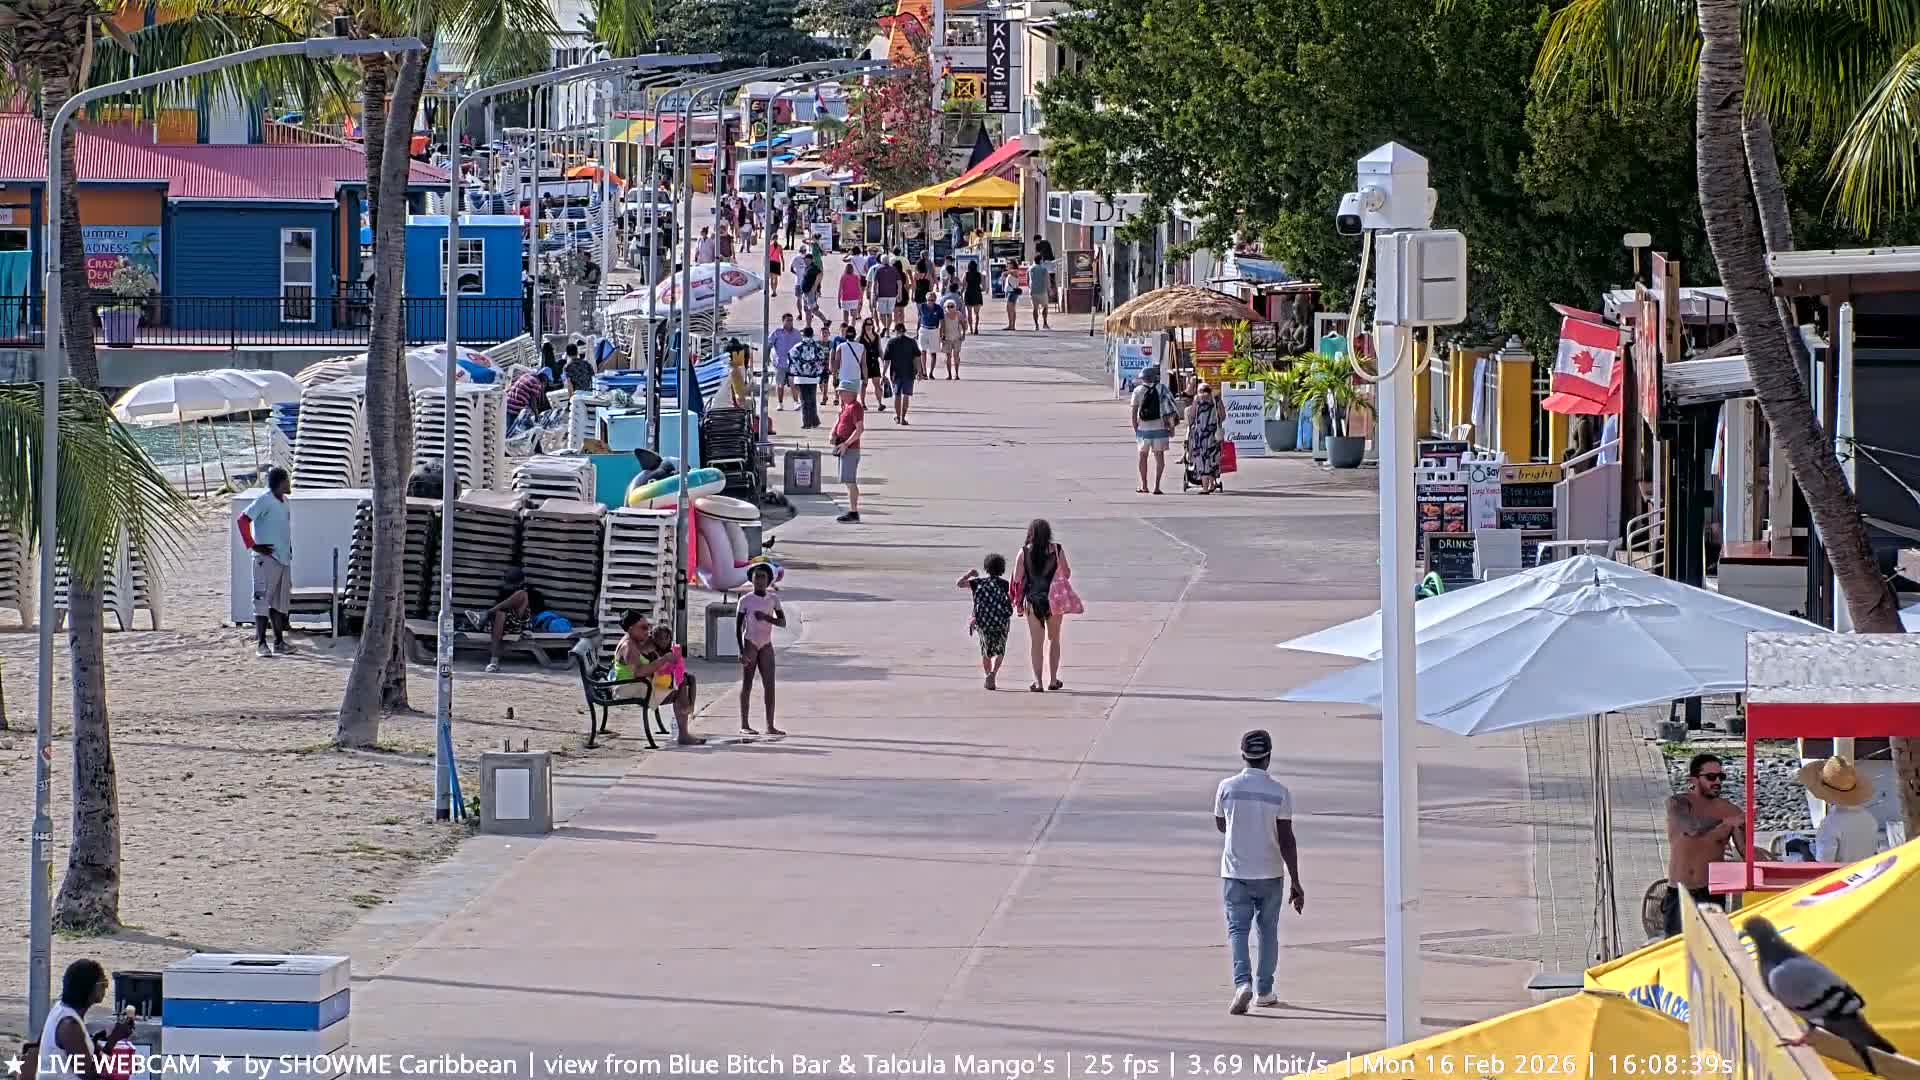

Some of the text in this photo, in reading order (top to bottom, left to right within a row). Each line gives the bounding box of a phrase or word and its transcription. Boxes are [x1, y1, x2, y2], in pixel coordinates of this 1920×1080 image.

[992, 22, 1006, 80] KAY'S
[1094, 200, 1128, 223] Di
[83, 230, 128, 238] ummer
[84, 243, 129, 253] ADNESS
[1439, 538, 1474, 550] DRINKS
